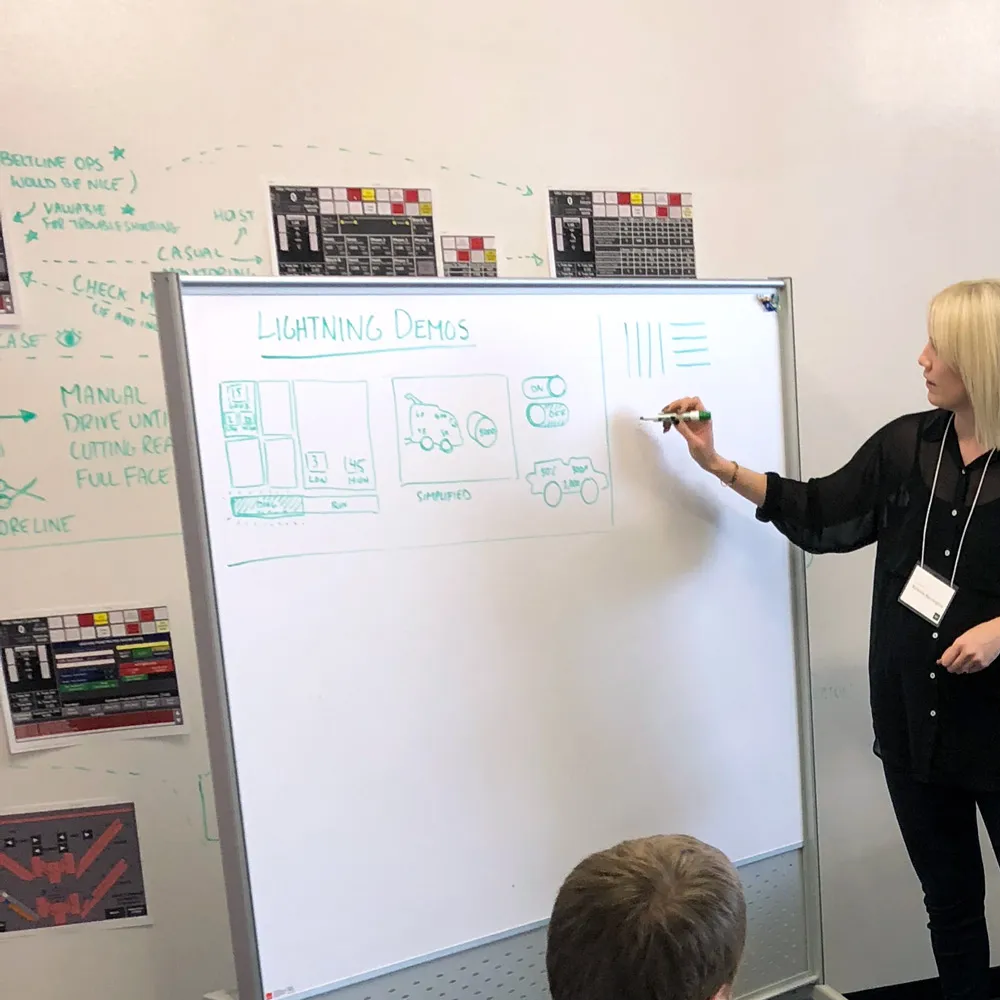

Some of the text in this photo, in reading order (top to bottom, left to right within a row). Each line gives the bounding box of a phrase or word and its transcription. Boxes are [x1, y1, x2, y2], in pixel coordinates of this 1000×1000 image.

[213, 208, 255, 222] HOST
[157, 246, 224, 260] CASUAL
[73, 274, 127, 301] CHECK
[257, 308, 470, 342] LIGHTNING DEMOS
[60, 384, 146, 408] MANUAL
[62, 410, 168, 431] DRIVE UNTI
[69, 440, 135, 460] CUTTING
[75, 466, 172, 489] FULL FACE
[416, 488, 472, 502] SIMPLIFIED
